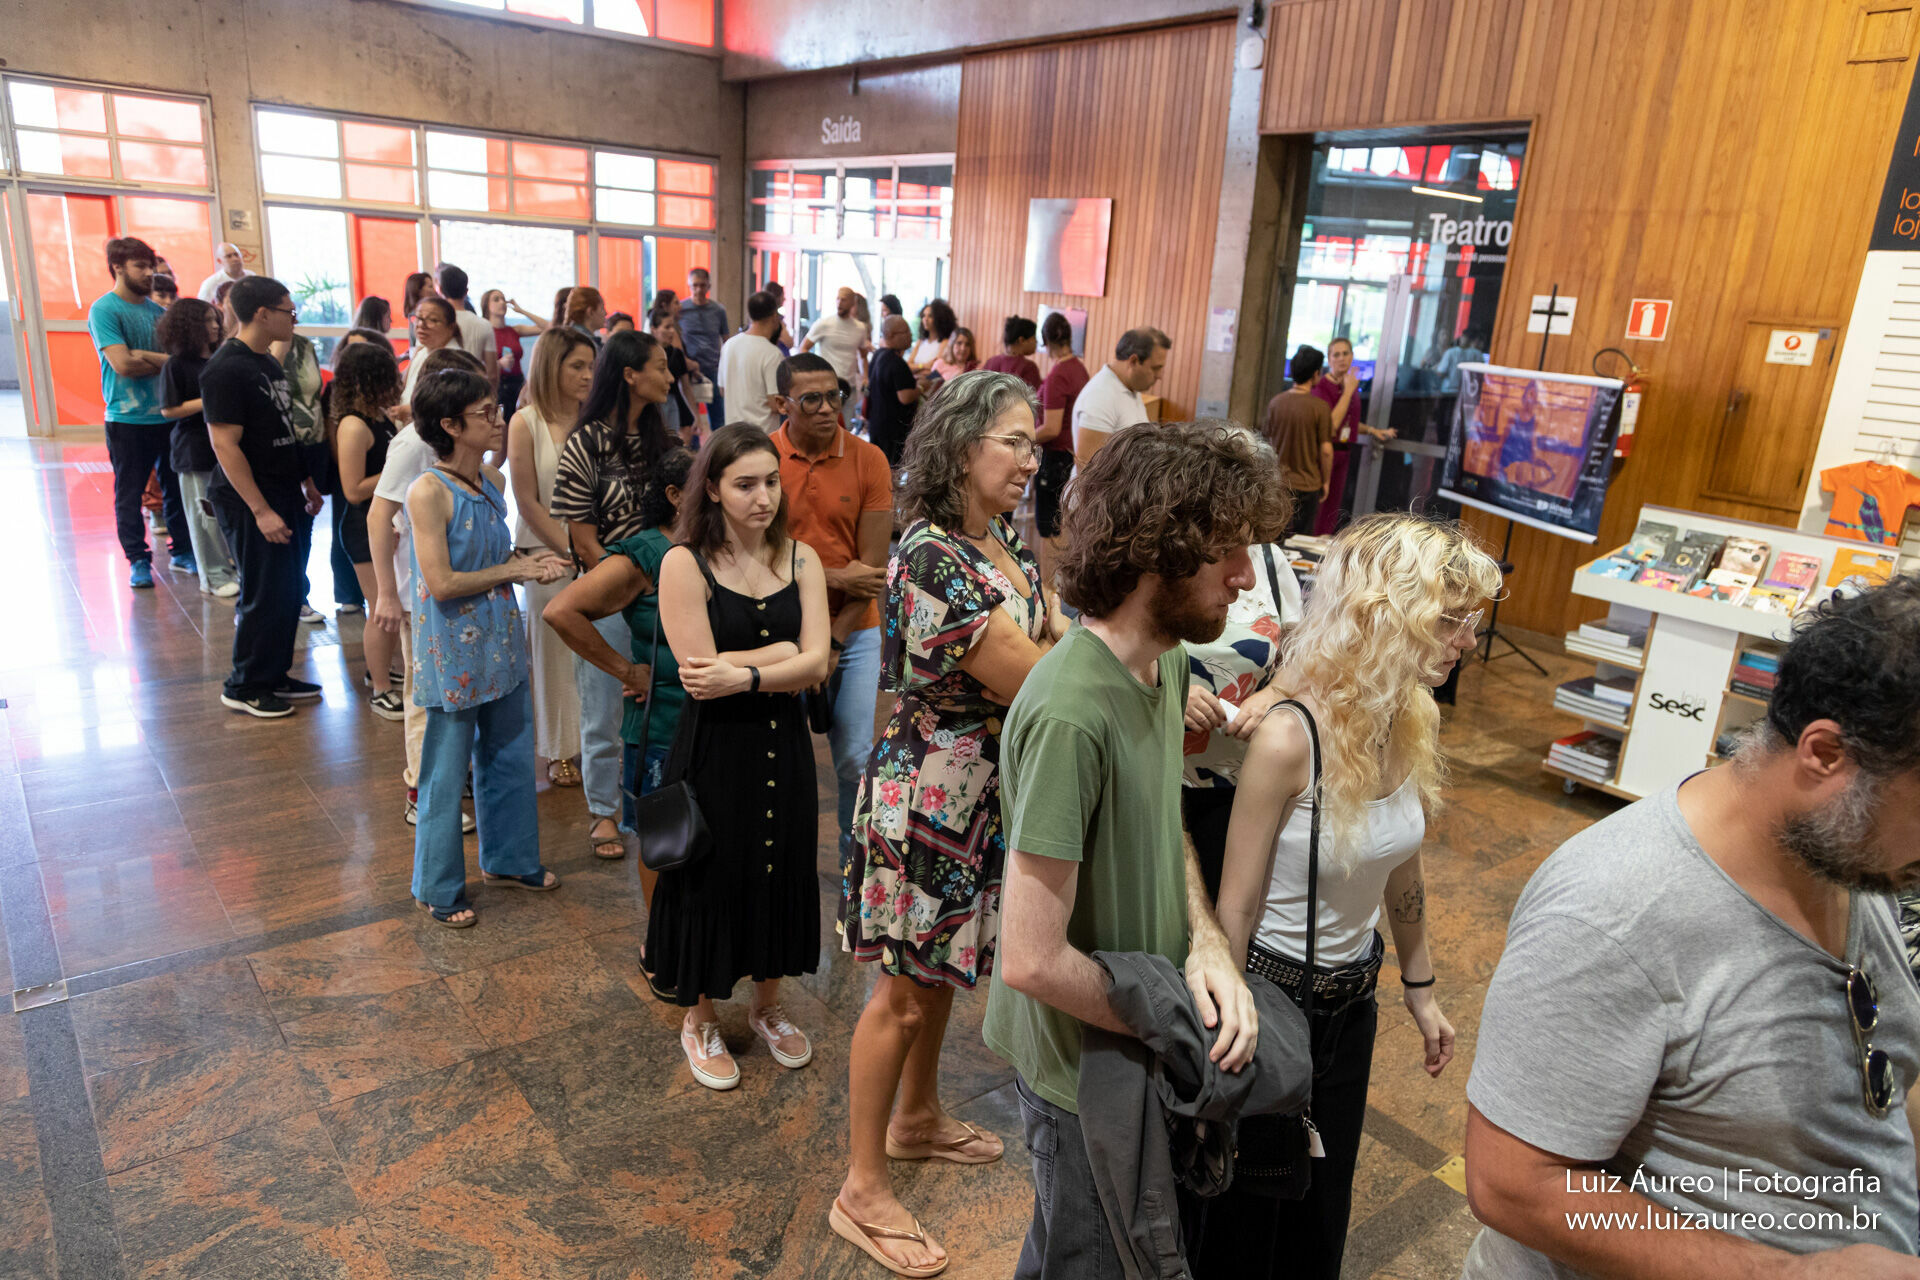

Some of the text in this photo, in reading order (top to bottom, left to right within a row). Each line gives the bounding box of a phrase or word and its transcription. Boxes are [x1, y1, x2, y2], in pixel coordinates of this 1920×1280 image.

[822, 115, 861, 144] Saída
[1900, 187, 1920, 210] lo
[1429, 213, 1513, 247] Teatro
[1893, 213, 1920, 240] loj
